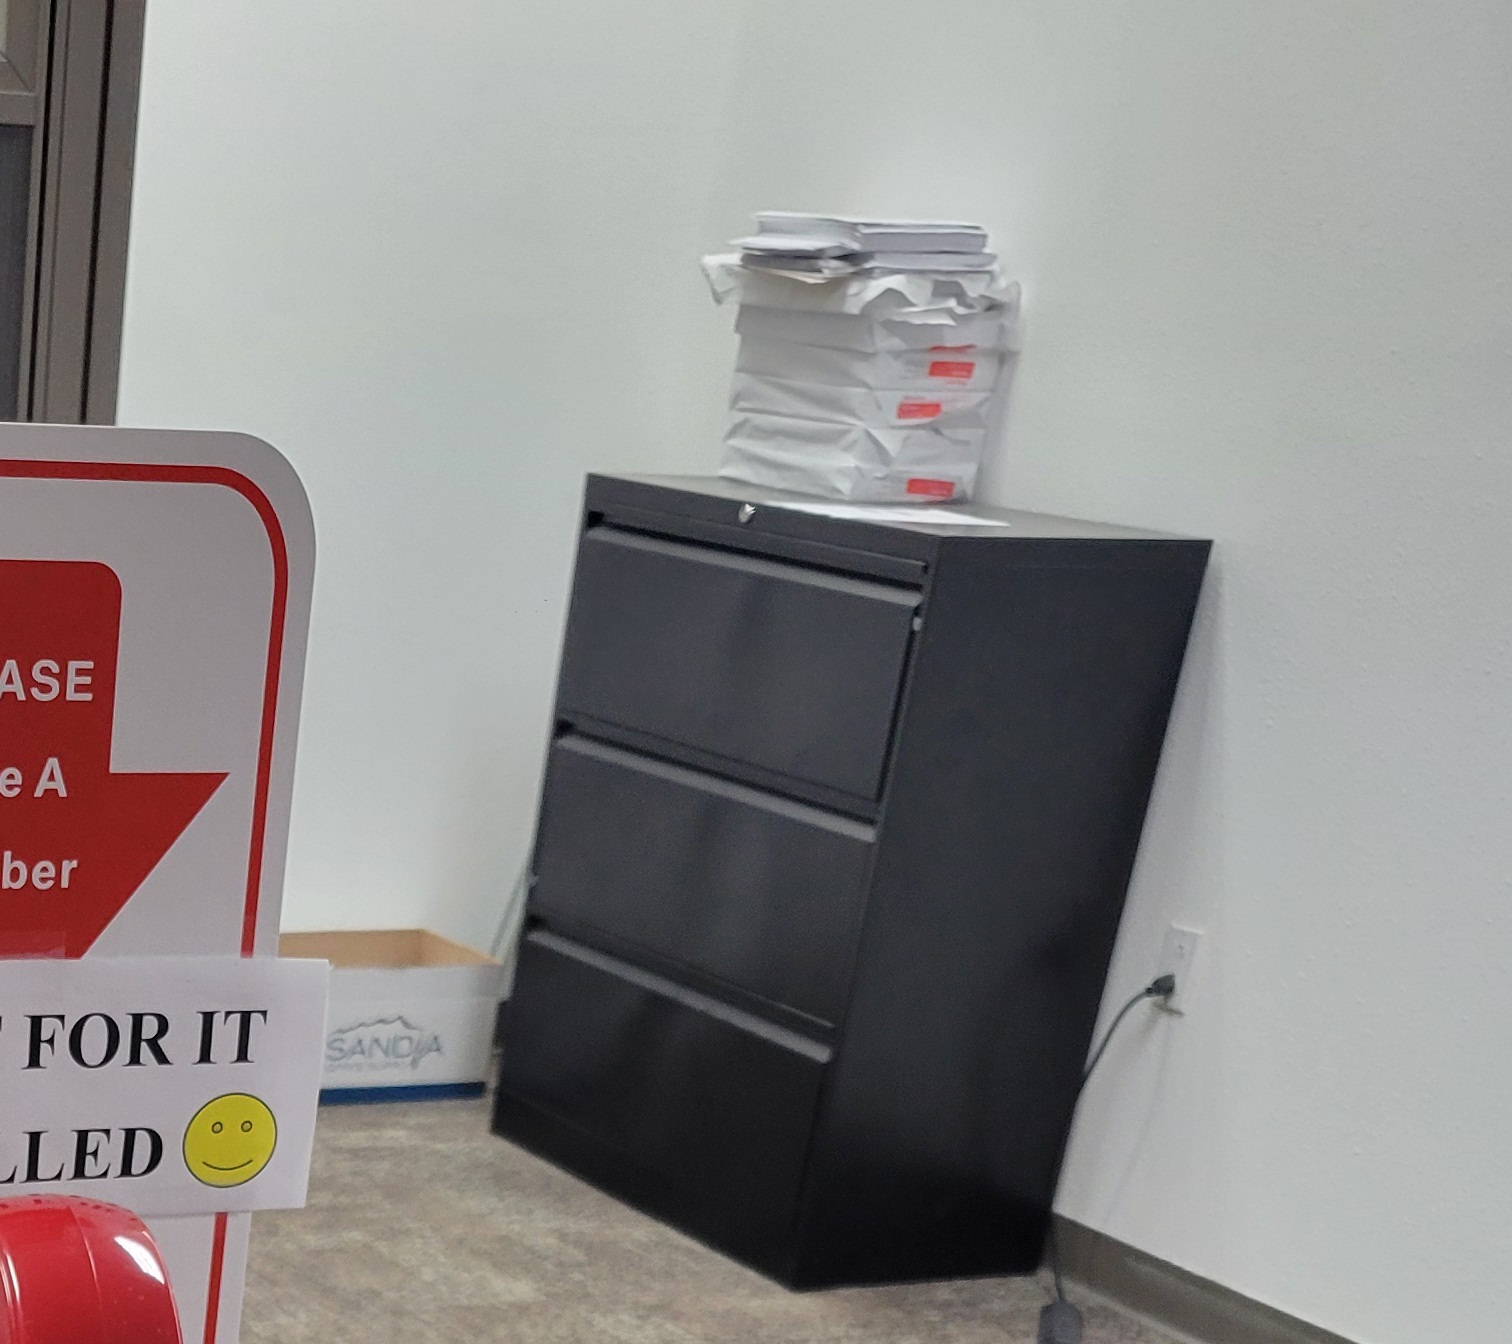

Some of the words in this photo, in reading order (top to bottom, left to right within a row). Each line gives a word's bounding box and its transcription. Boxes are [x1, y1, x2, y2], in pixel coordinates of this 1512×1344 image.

[33, 757, 69, 799] A
[20, 1011, 174, 1071] FOR
[191, 1008, 268, 1066] IT
